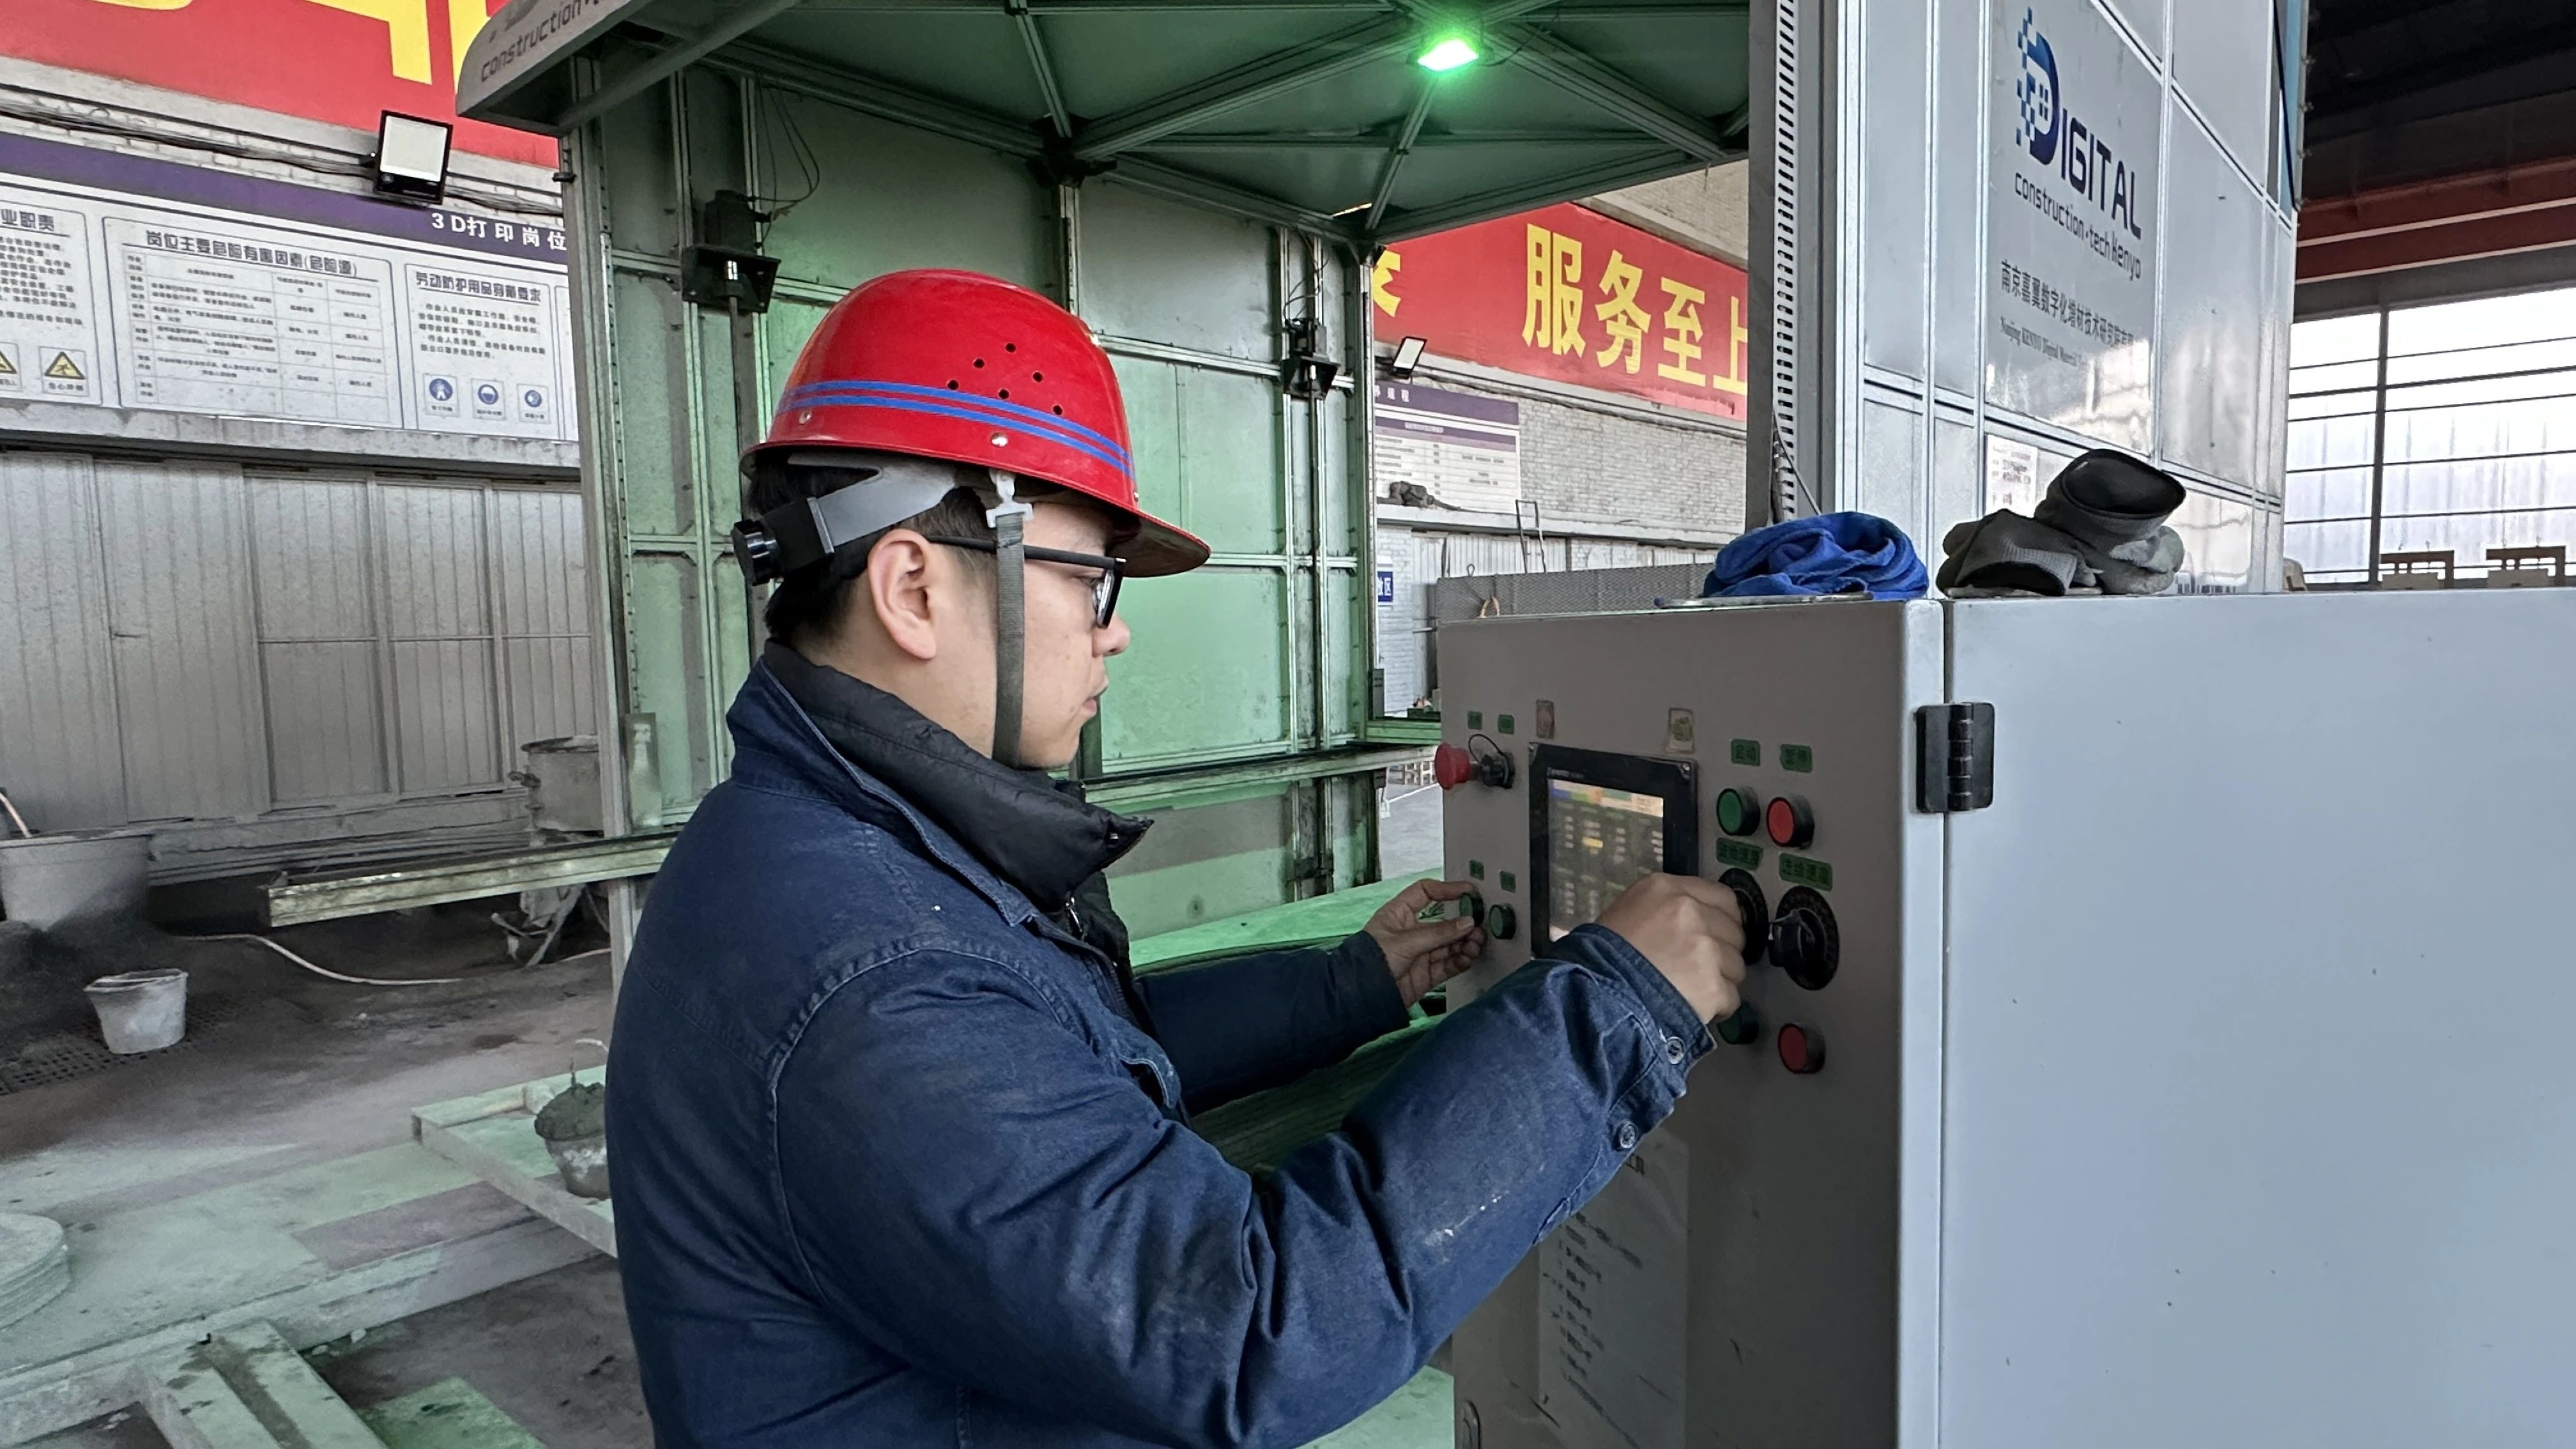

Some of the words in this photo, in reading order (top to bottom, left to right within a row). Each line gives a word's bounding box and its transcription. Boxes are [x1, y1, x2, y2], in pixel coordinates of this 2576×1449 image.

[2016, 6, 2141, 240] DIGITAL
[431, 212, 567, 251] 3D打印岗位
[1522, 223, 1747, 396] 服务至上
